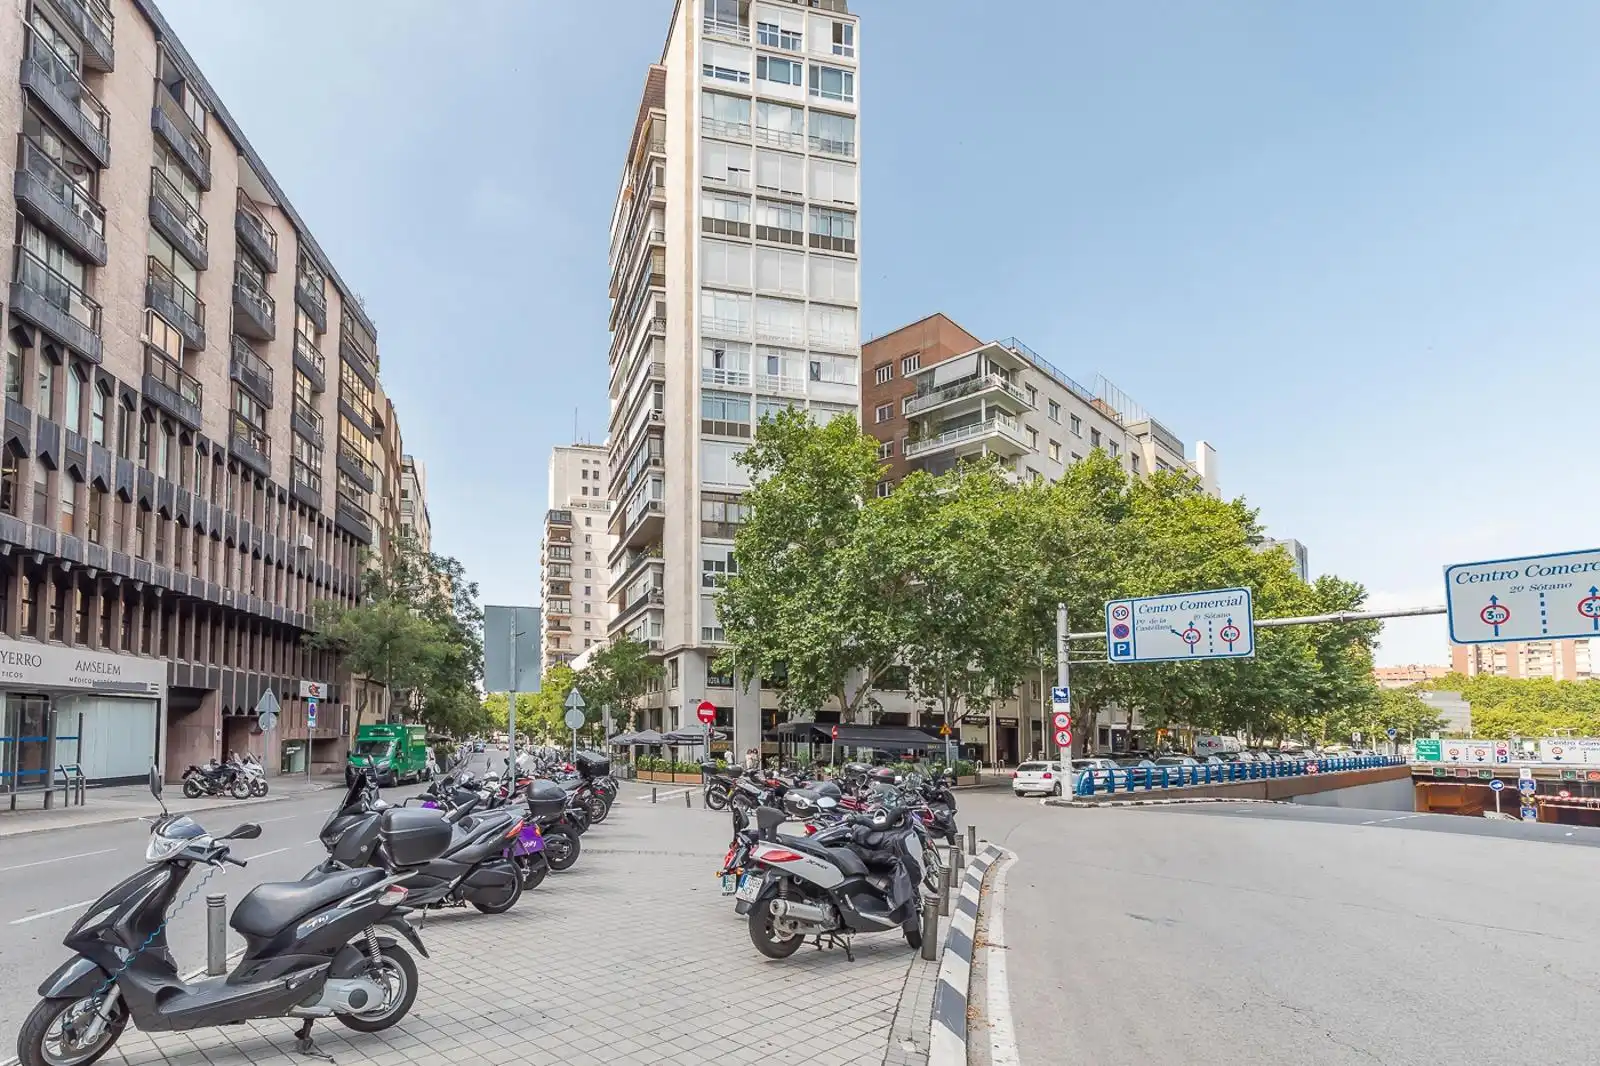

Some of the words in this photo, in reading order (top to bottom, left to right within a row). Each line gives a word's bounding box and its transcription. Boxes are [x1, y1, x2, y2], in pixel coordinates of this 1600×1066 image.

[1456, 569, 1519, 585] Centro
[1529, 582, 1573, 592] Sótano
[1115, 609, 1127, 617] 50
[1138, 602, 1177, 615] Centro
[1179, 596, 1244, 611] Comercial
[0, 650, 42, 667] YERRO
[75, 660, 121, 676] AMSELEM
